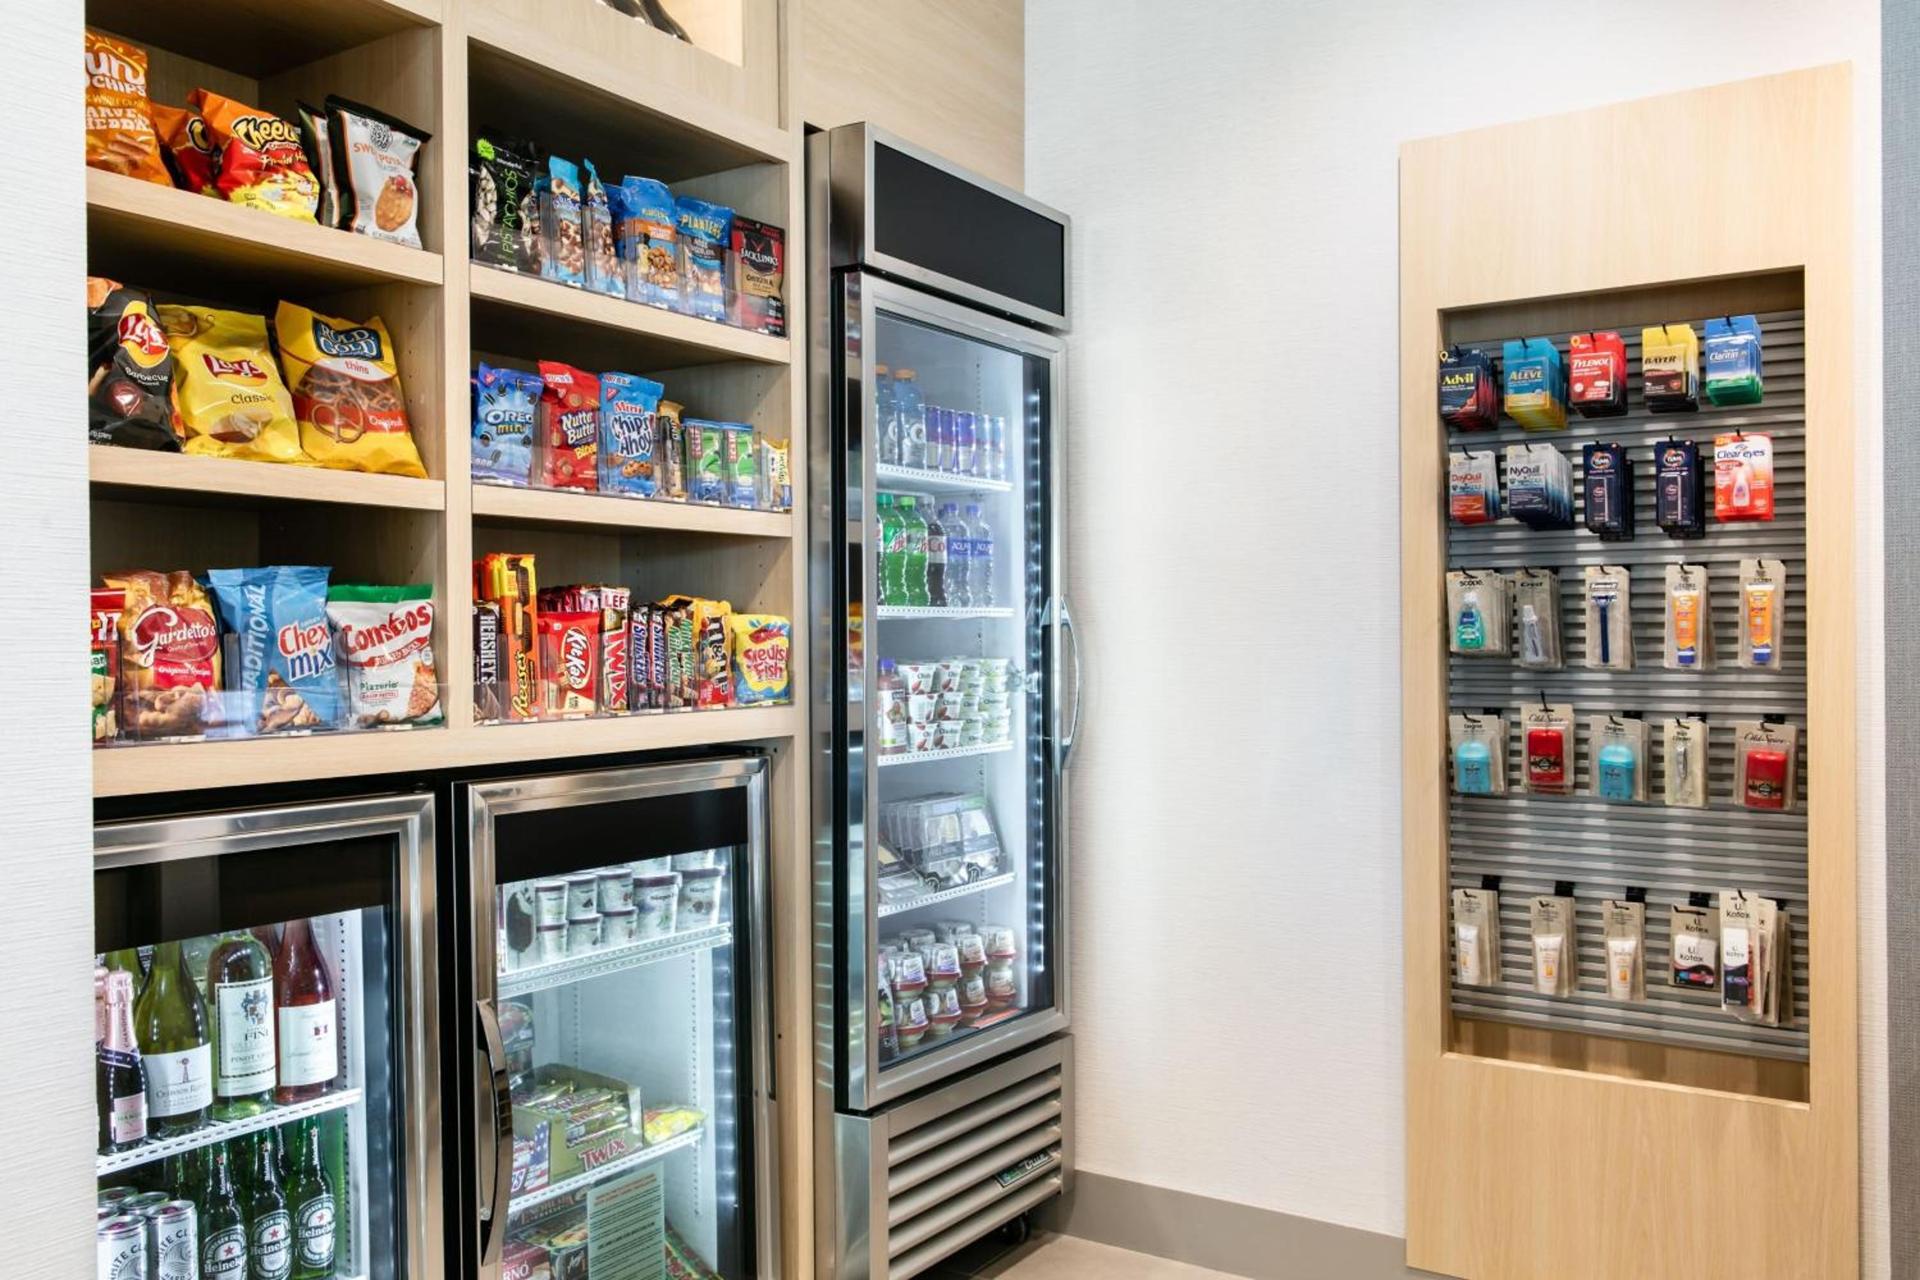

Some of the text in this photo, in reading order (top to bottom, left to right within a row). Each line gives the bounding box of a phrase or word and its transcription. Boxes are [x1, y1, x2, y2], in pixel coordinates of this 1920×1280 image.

[86, 51, 145, 84] un
[92, 75, 146, 97] CHIPS
[319, 324, 371, 344] ROLD
[320, 336, 378, 356] GOLD
[1709, 351, 1739, 361] Claritin
[208, 355, 263, 375] Lay's
[1573, 358, 1609, 369] TYLENOL
[1644, 355, 1677, 365] BAYER
[1442, 372, 1474, 385] Advil
[1509, 370, 1543, 381] ALEVE
[485, 409, 534, 425] OREO
[611, 414, 651, 442] Chips
[1717, 449, 1765, 460] Clear eyes
[1452, 472, 1482, 484] DayQuil
[1510, 465, 1540, 477] NyQuil
[1459, 579, 1482, 588] scope
[604, 594, 626, 608] LEF
[132, 606, 217, 668] Gardetto's
[280, 622, 330, 657] Chex
[340, 605, 431, 656] Combos
[288, 641, 336, 681] mix
[605, 622, 629, 709] TWIX
[754, 659, 784, 681] Fish
[578, 1134, 627, 1172] TWIX
